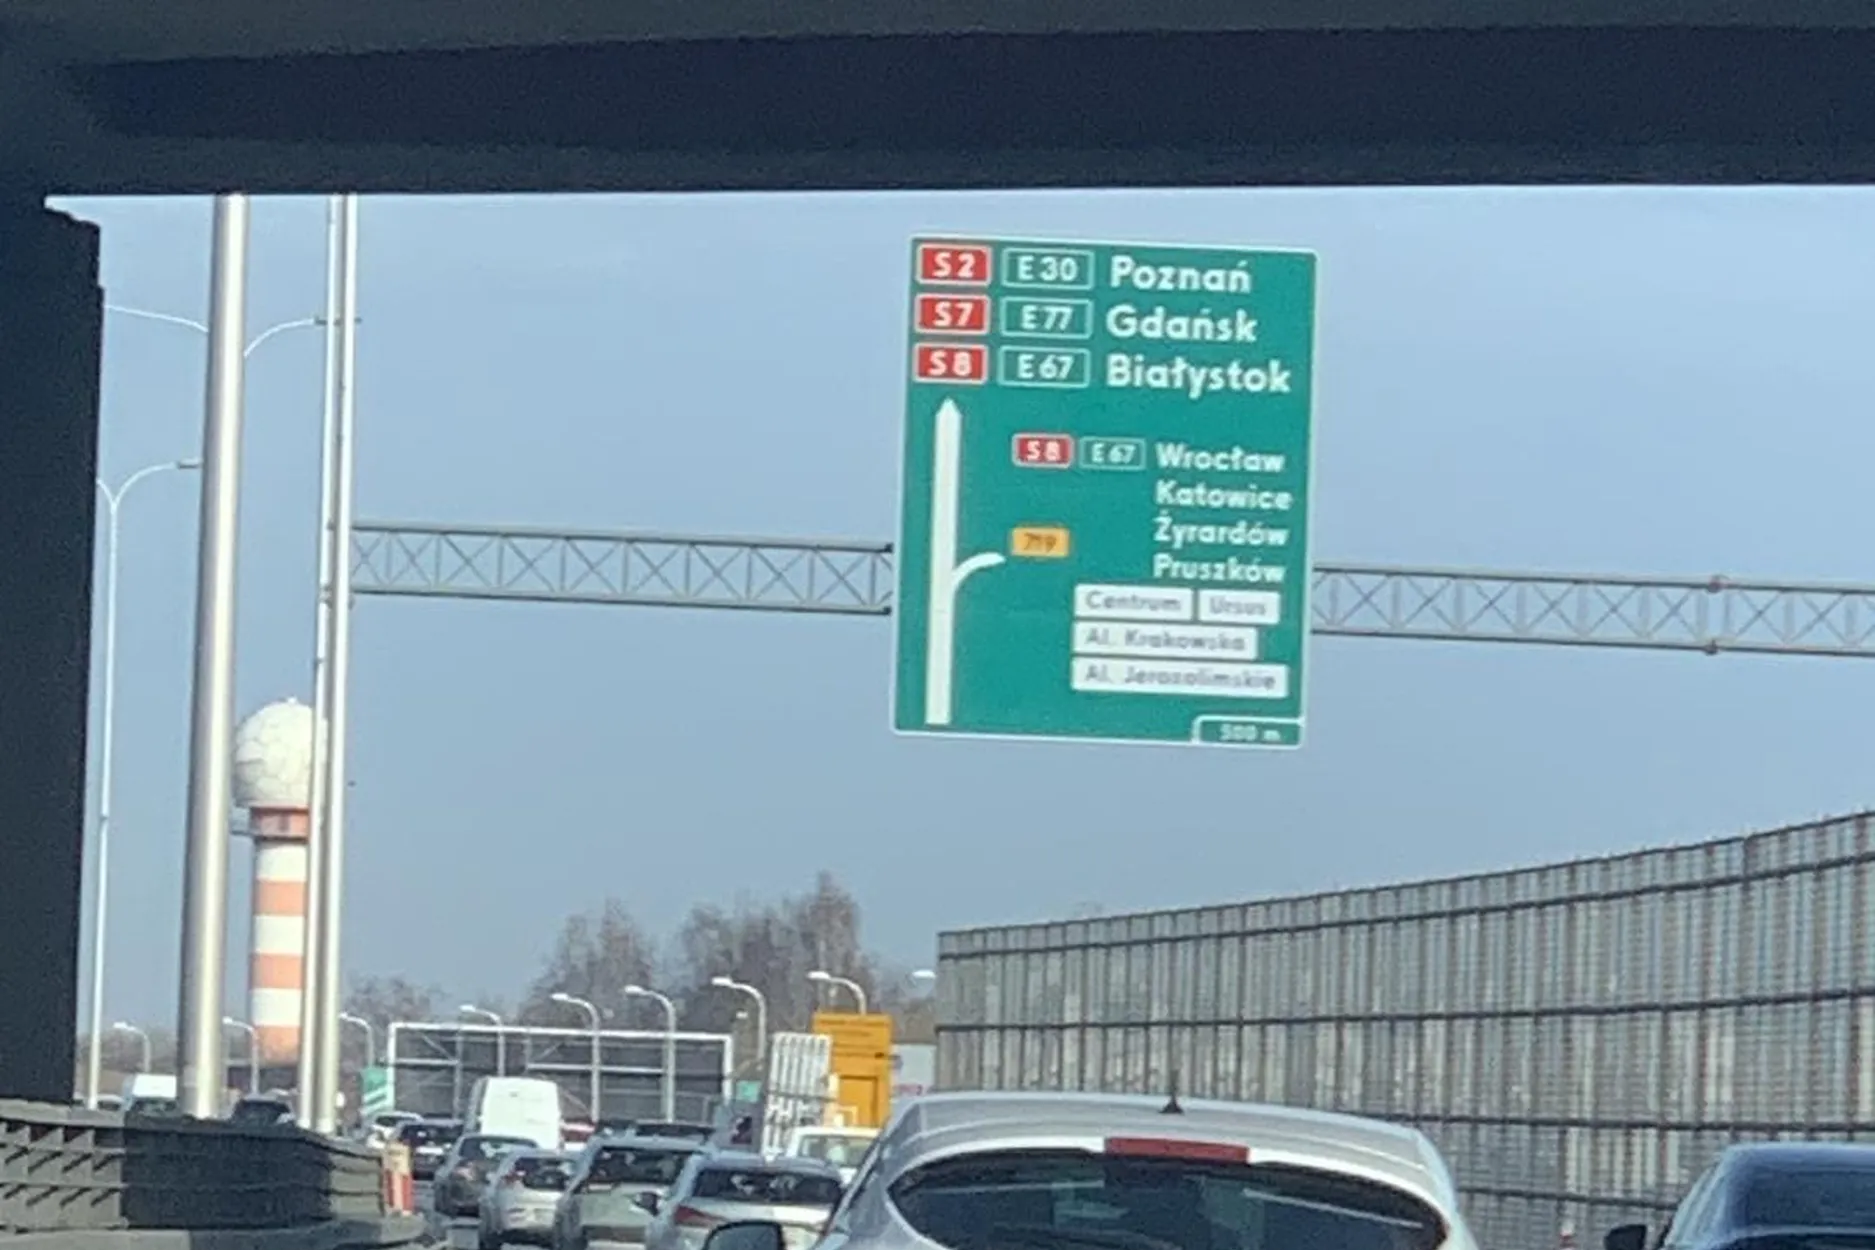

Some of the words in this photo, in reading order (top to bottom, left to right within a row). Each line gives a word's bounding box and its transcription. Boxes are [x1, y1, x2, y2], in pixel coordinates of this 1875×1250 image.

[1110, 254, 1251, 292] Poznań
[1106, 303, 1258, 342] Gdańsk
[1107, 353, 1292, 400] Białystok
[1155, 442, 1286, 473] Wrocław
[1154, 480, 1294, 510] Katowice
[1153, 510, 1291, 549] Żyrardów
[1153, 554, 1287, 583] Pruszków
[1085, 590, 1182, 611] Centrum
[1125, 630, 1246, 651] Krakowska
